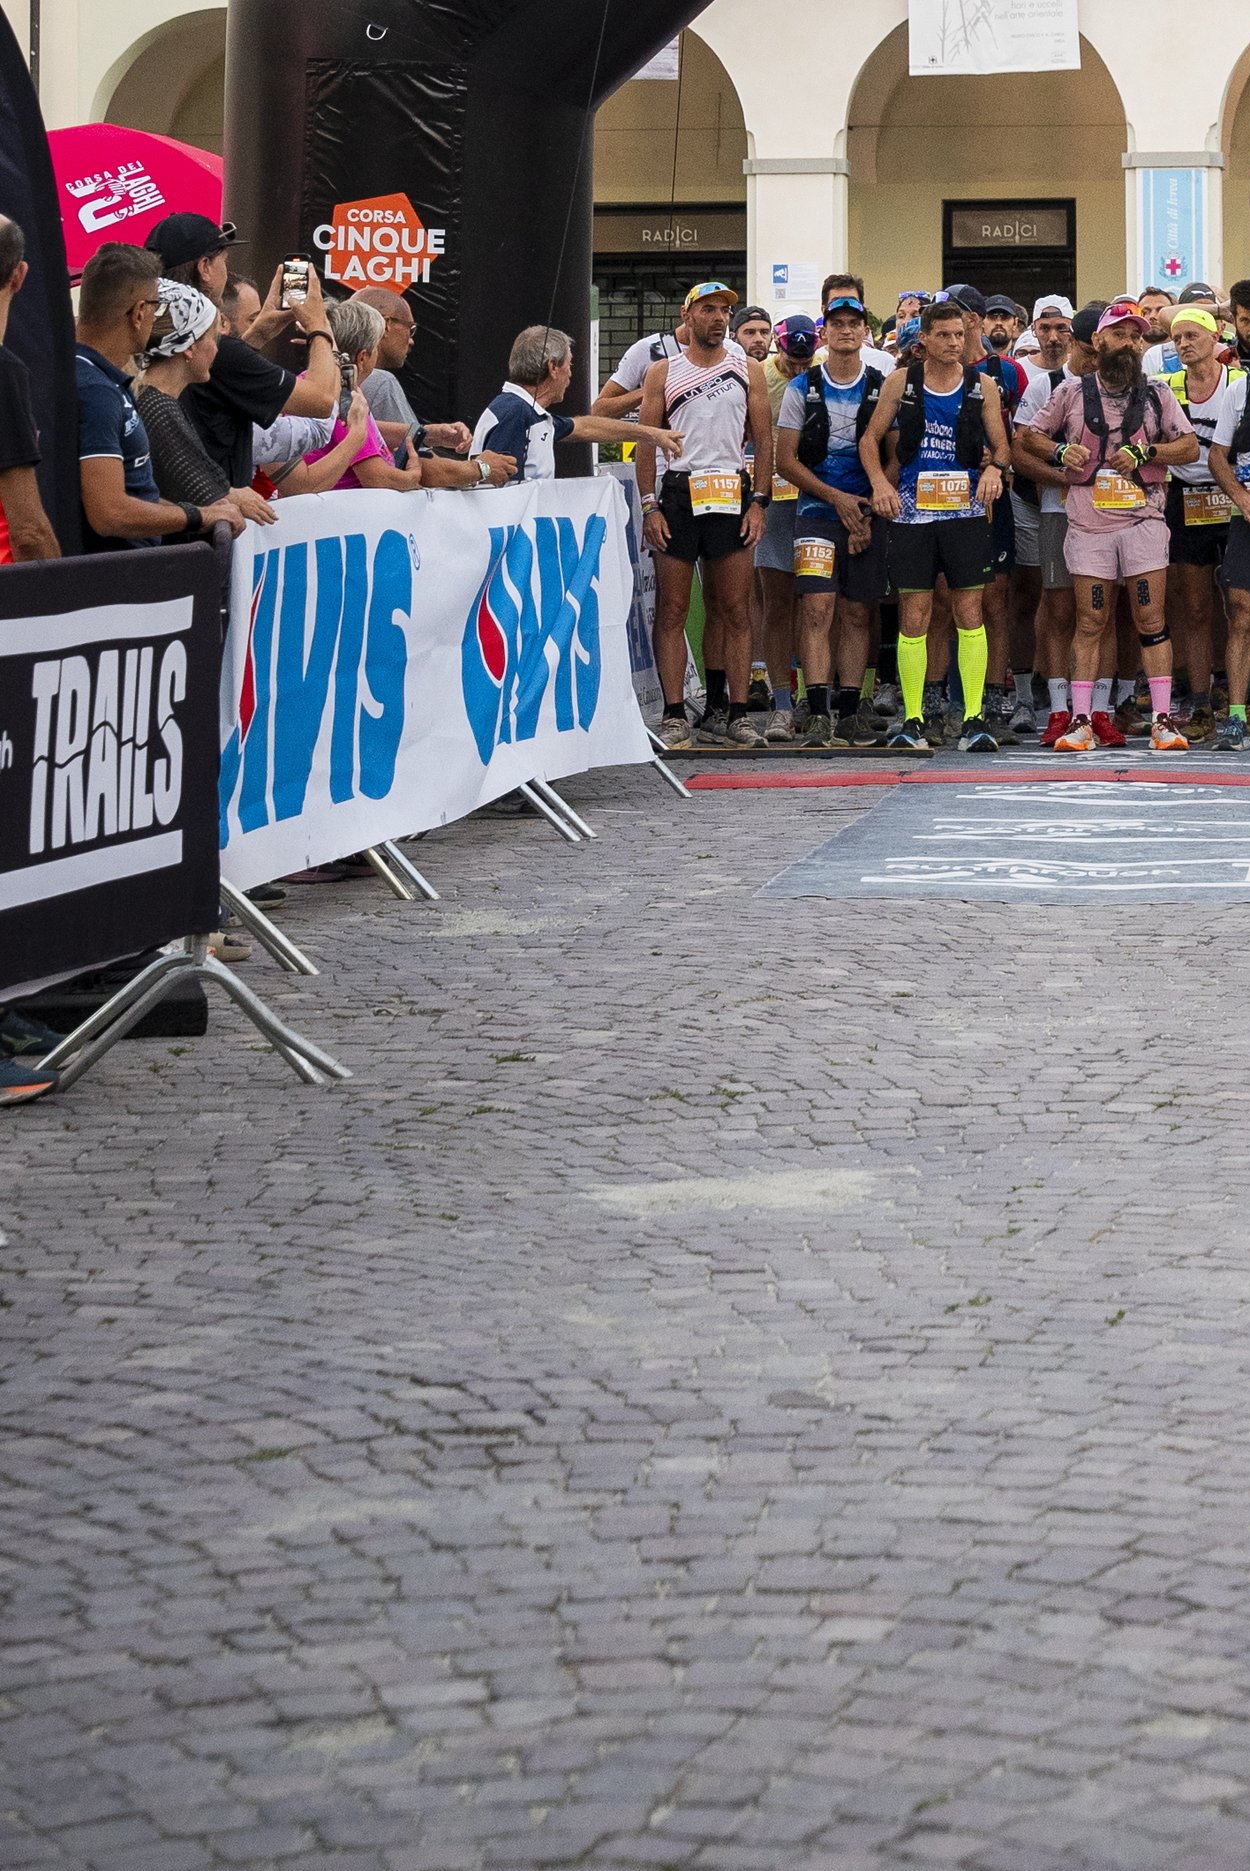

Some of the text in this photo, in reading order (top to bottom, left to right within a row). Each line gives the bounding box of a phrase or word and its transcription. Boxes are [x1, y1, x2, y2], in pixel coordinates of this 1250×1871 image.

[65, 160, 144, 191] CORSA DEI
[118, 167, 166, 217] LAGHI
[347, 208, 406, 223] CORSA
[312, 224, 446, 255] CINQUE
[324, 254, 431, 283] LAGHI
[712, 478, 739, 489] 1157
[940, 480, 967, 491] 1075
[805, 546, 832, 559] 1152
[29, 639, 188, 855] TRAILS
